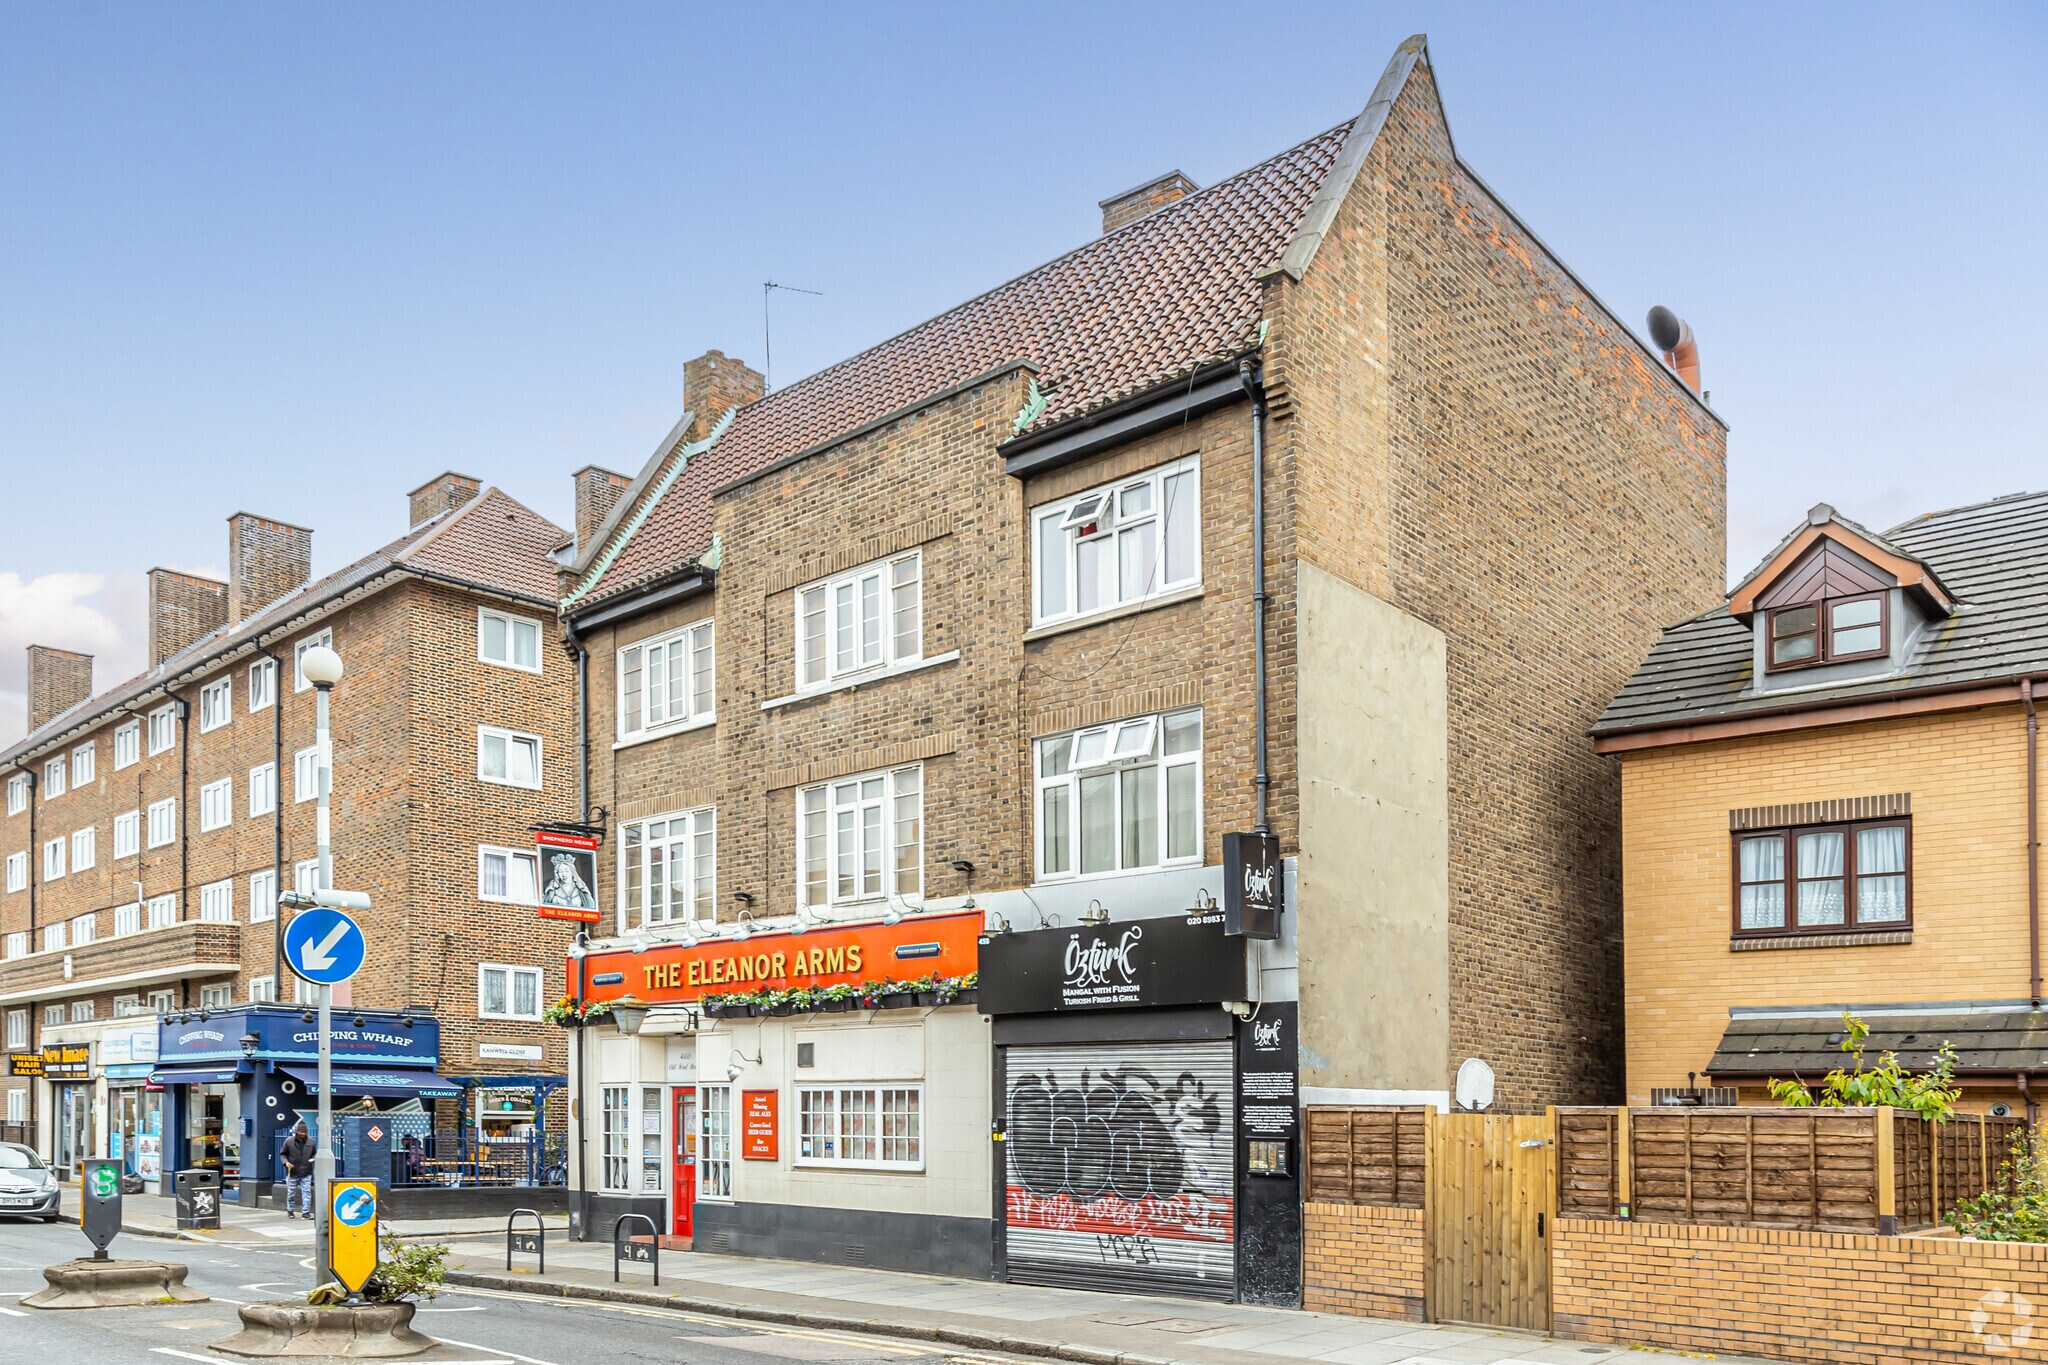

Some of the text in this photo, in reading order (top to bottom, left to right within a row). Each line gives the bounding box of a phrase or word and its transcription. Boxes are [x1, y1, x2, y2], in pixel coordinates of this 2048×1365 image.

[542, 835, 573, 844] SHEPHERD
[557, 910, 582, 918] ELEANOR
[1187, 916, 1202, 926] 020
[1063, 925, 1143, 987] Öztürk
[643, 945, 863, 989] THE ELEANOR ARMS
[1062, 984, 1140, 997] MANGAL WITH FUSION
[1063, 994, 1140, 1005] TURKISH FRIED & GRILL
[293, 1031, 414, 1047] CHIPING WHARF
[43, 1046, 89, 1063] New Image
